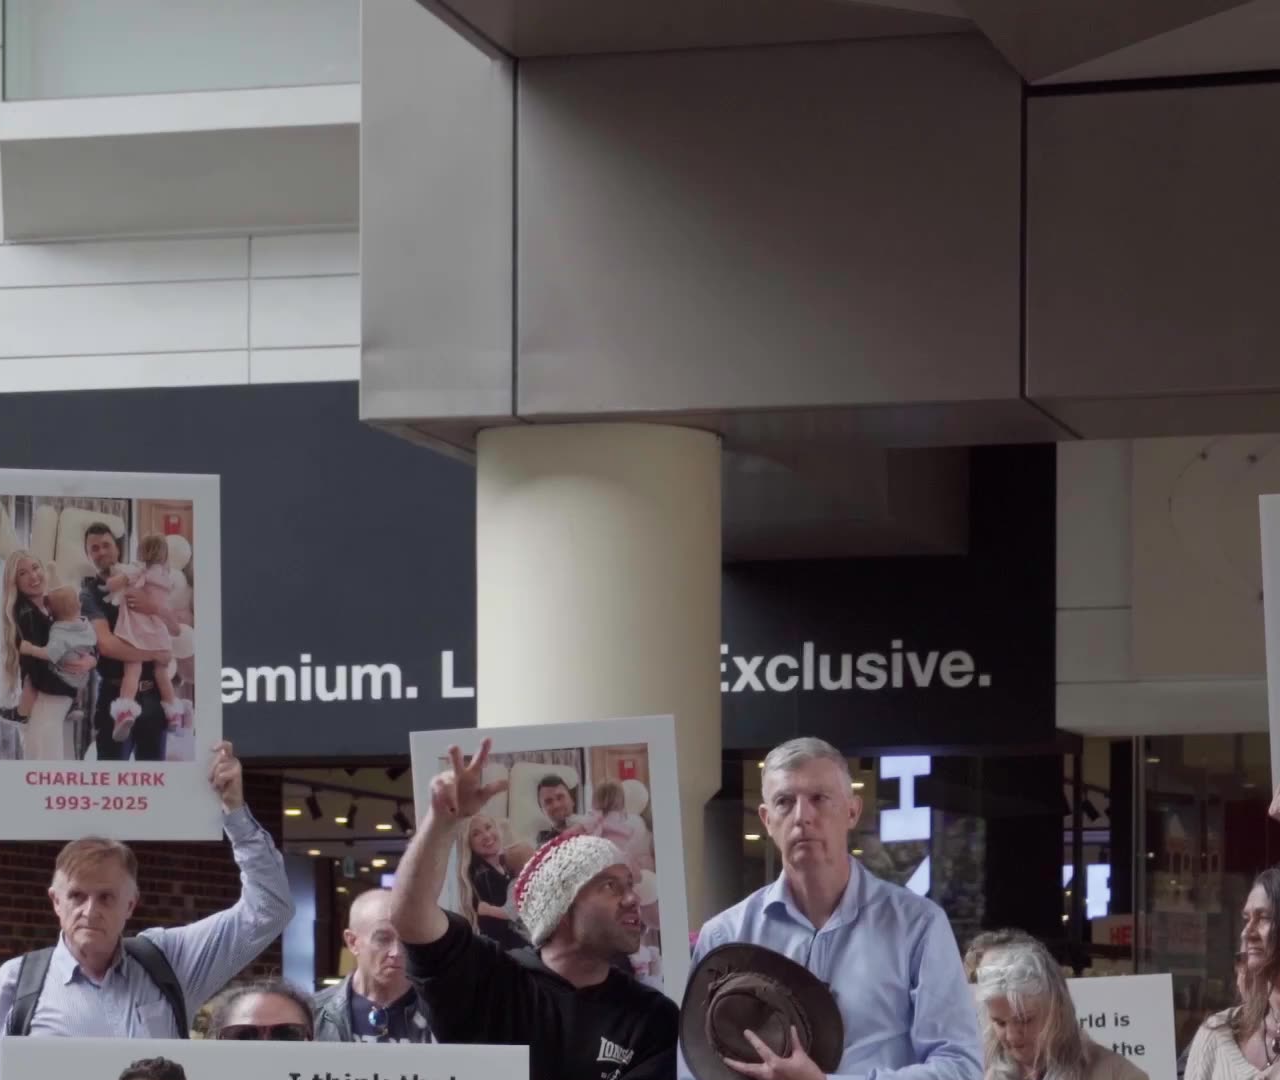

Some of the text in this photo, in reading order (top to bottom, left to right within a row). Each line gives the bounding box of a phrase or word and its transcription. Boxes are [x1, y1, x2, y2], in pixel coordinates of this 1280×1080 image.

[221, 650, 474, 703] emium. L
[26, 772, 164, 786] CHARLIE KIRK
[45, 796, 148, 810] 1993-2025
[1080, 1012, 1130, 1028] rld is
[1112, 1042, 1145, 1056] the
